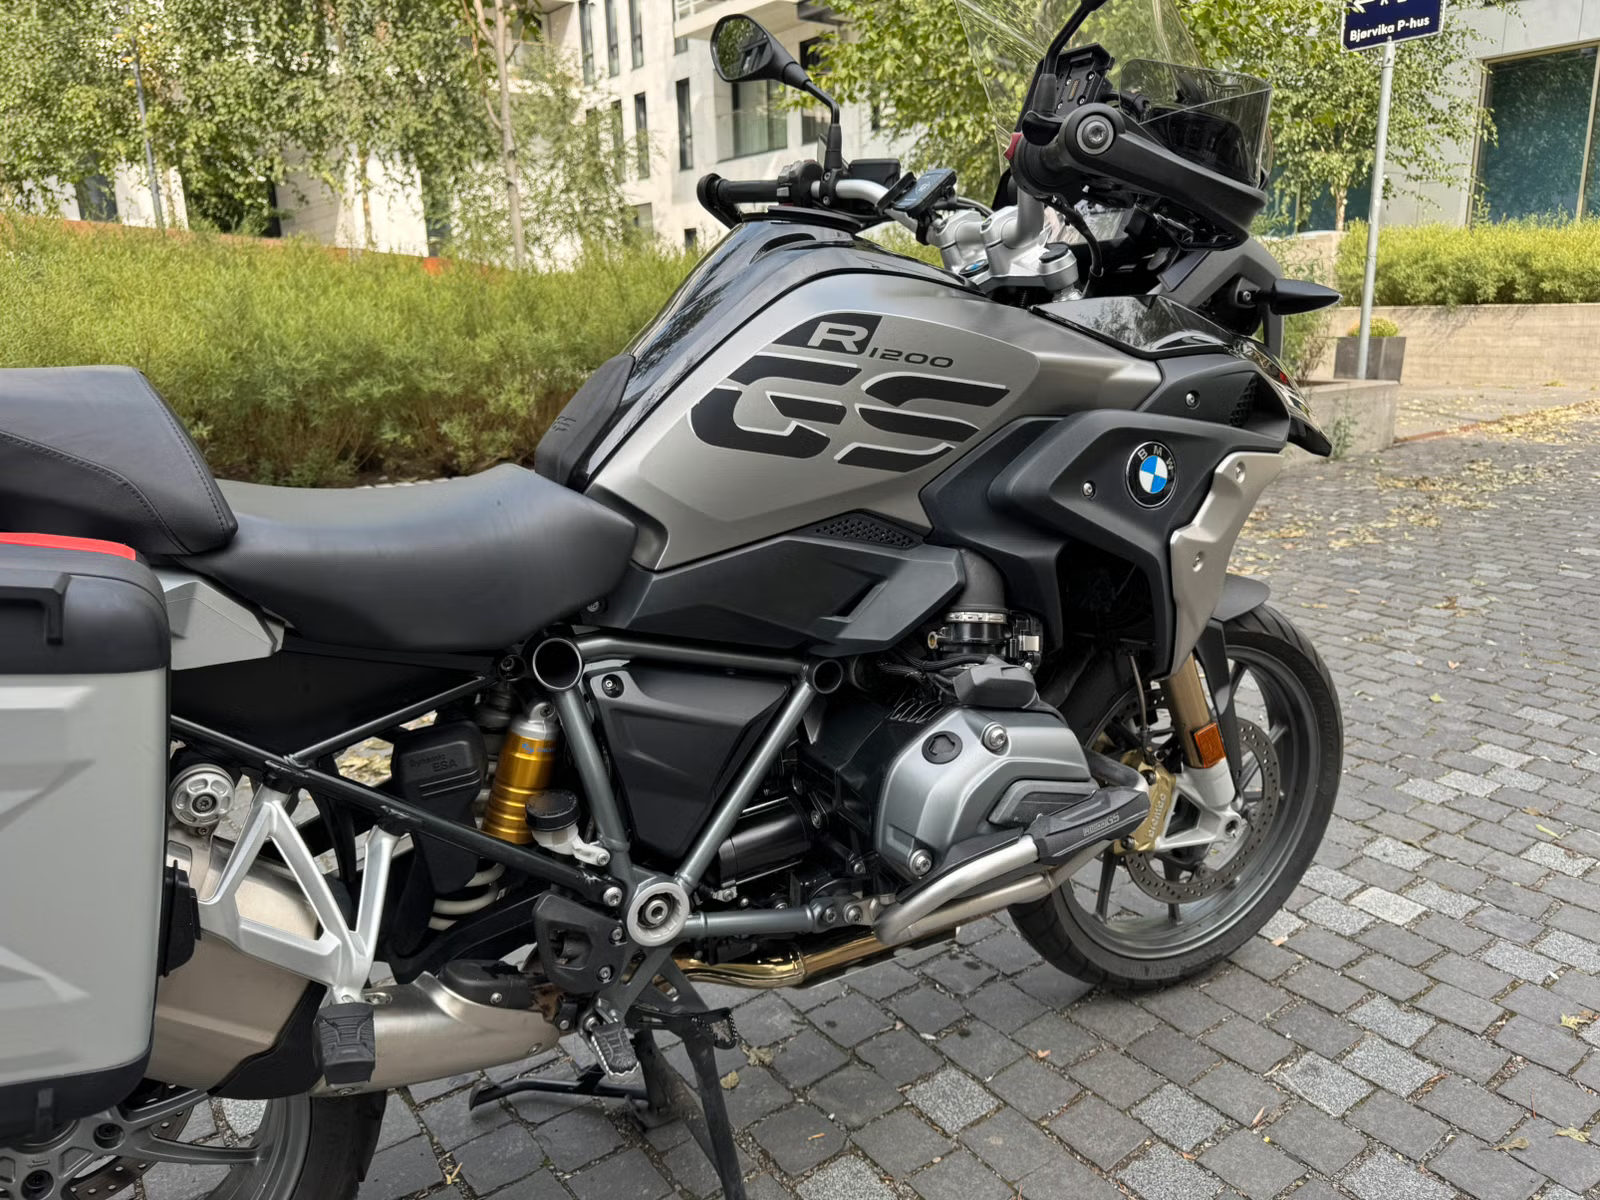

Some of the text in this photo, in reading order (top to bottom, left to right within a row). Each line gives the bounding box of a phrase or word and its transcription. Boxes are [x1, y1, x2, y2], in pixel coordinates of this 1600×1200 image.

[1350, 17, 1430, 42] Bjørvika P-hus
[807, 321, 955, 369] R 1200
[686, 350, 1011, 473] GS
[1137, 445, 1175, 474] BMW
[432, 758, 458, 772] ESA
